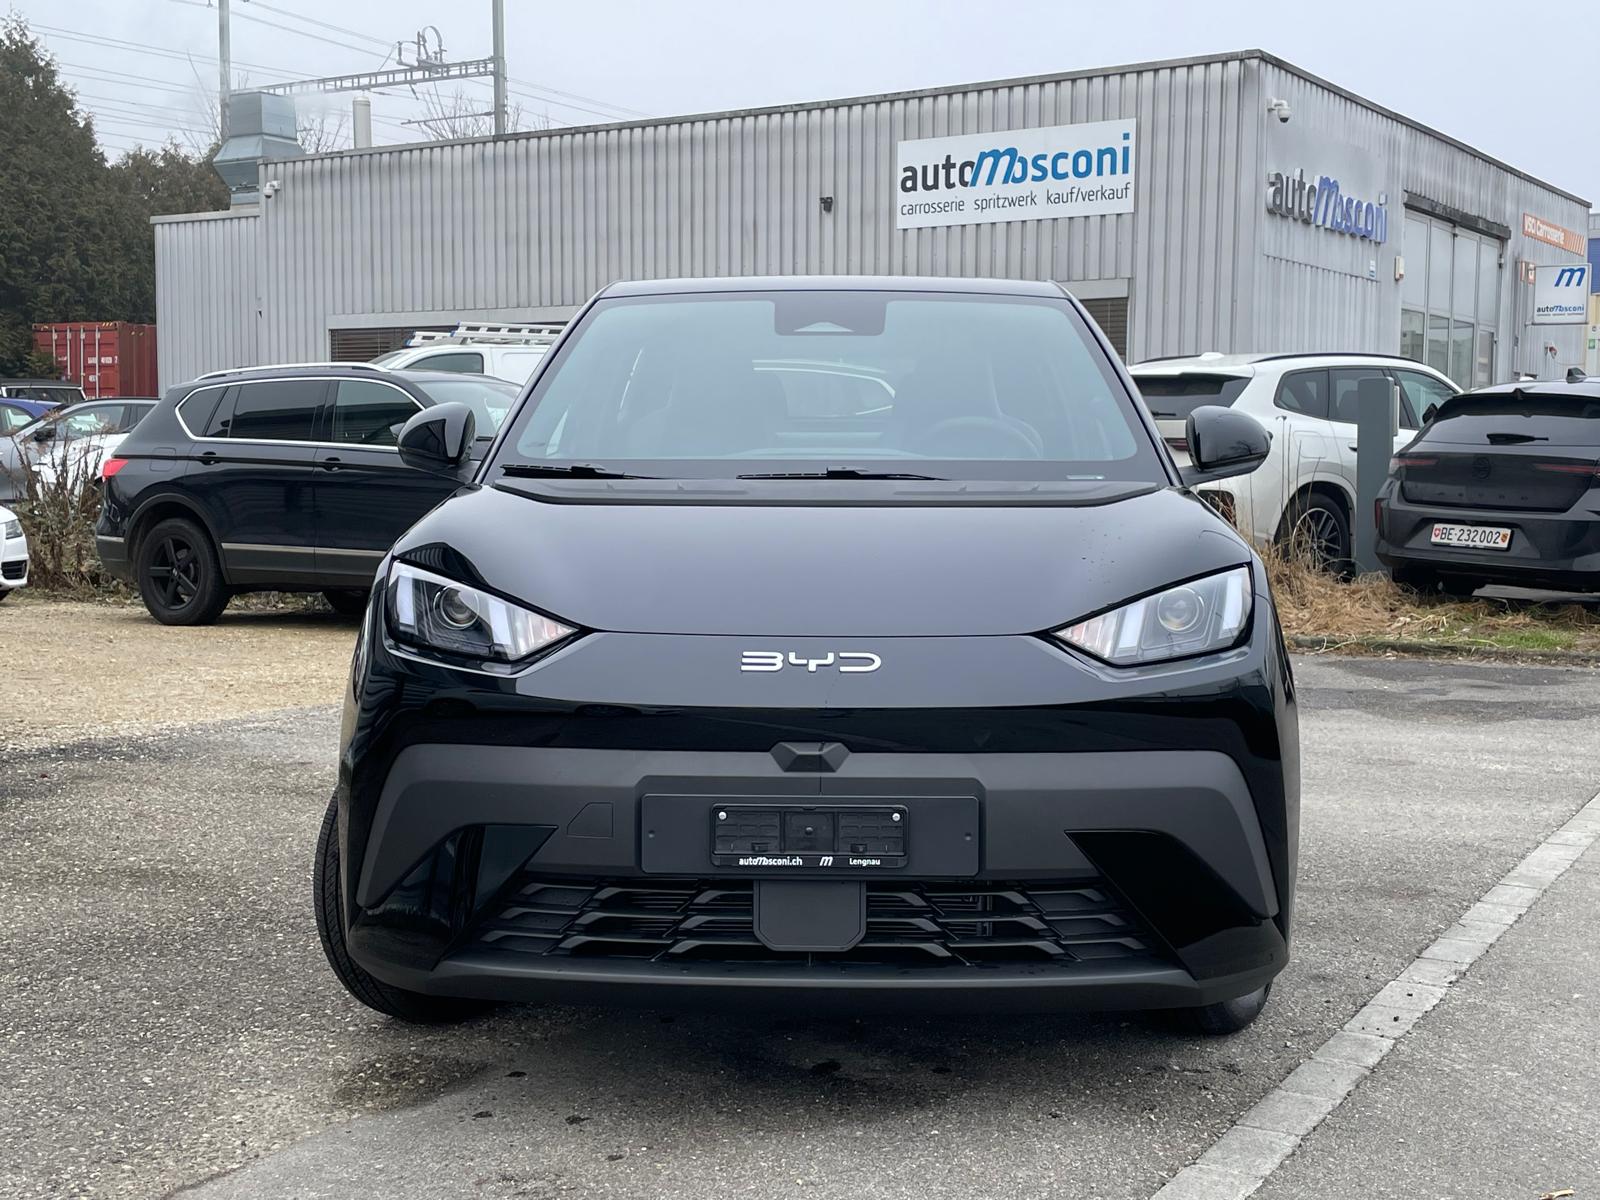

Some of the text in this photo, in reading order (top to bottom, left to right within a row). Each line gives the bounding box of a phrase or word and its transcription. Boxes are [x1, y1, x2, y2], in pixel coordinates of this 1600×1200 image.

[900, 182, 1131, 216] carrosserie spritzwerk kauf/verkauf
[740, 651, 882, 673] BYD
[849, 858, 881, 867] Lengnau
